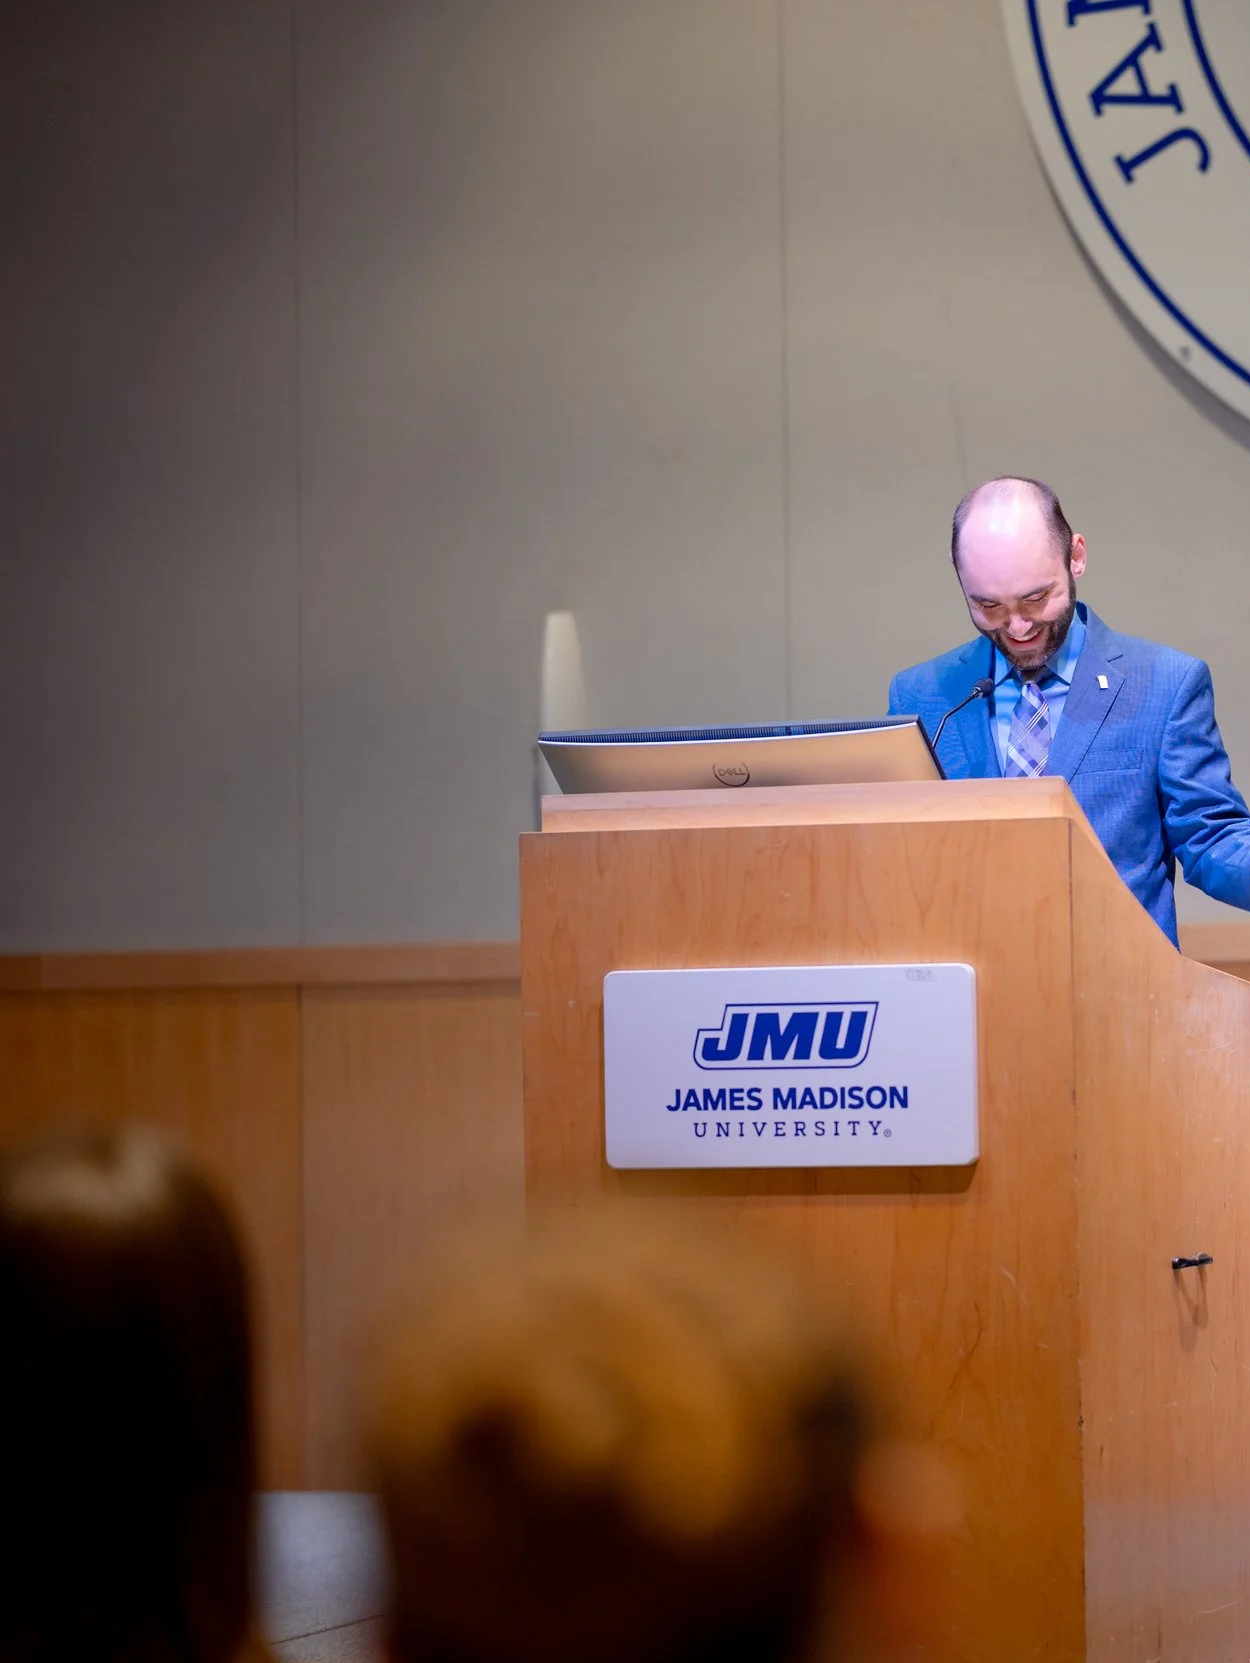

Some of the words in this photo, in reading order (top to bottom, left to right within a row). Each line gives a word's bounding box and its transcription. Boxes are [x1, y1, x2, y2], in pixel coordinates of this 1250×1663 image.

[700, 1010, 869, 1062] JMU
[665, 1087, 763, 1112] JAMES
[771, 1085, 909, 1111] MADISON
